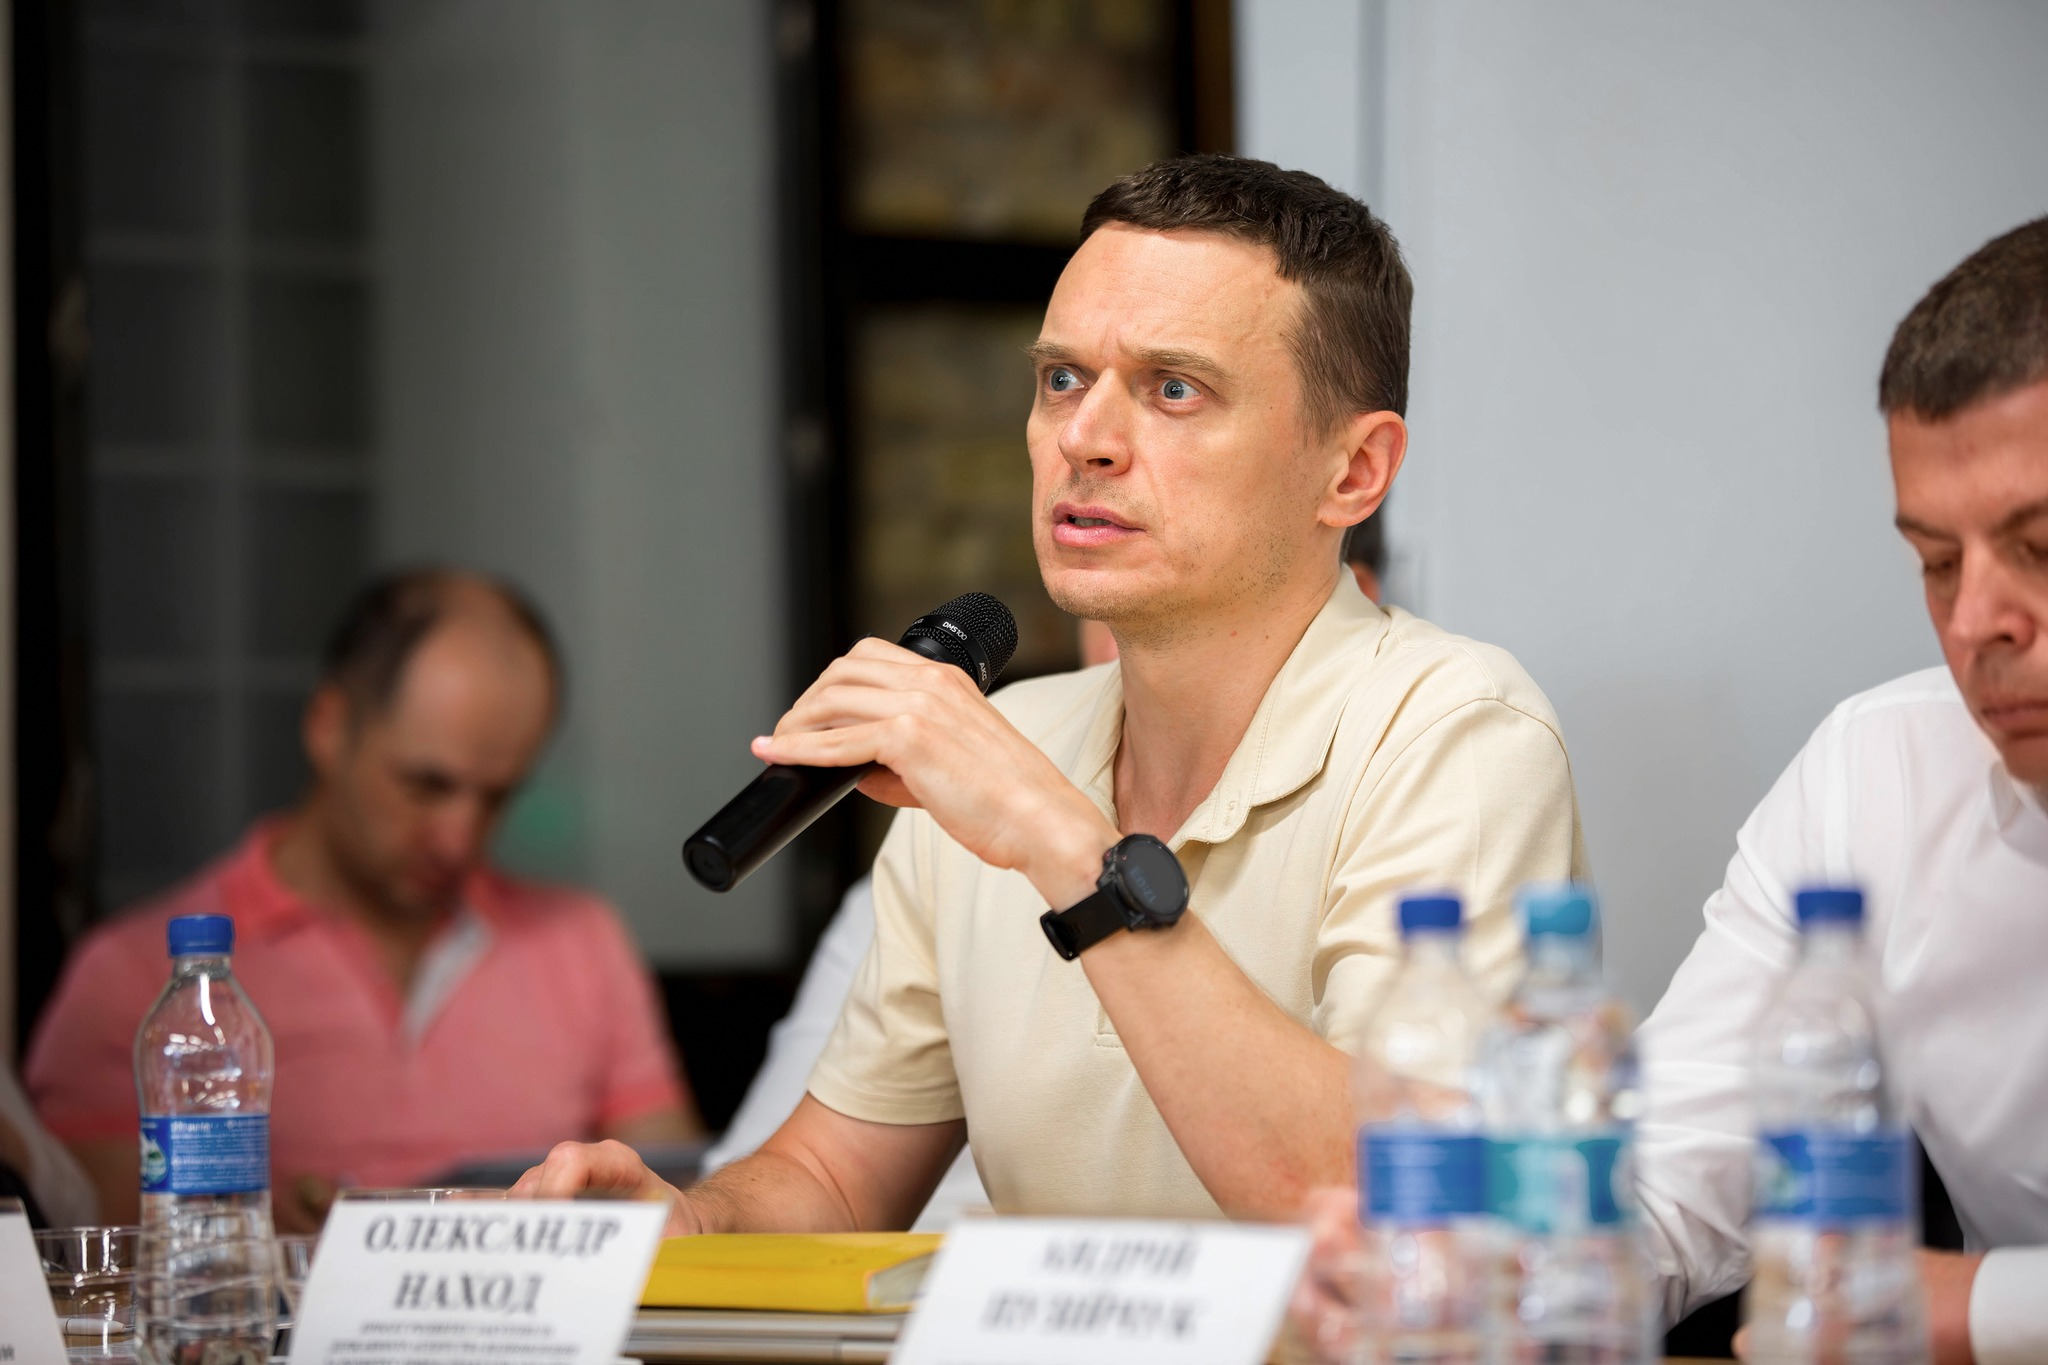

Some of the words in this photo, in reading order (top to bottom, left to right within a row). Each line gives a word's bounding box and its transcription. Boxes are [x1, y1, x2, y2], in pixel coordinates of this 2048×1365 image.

[942, 621, 968, 641] DMS100
[979, 662, 988, 681] AKG
[363, 1213, 621, 1258] ОЛЕКСАНДР
[393, 1271, 545, 1314] НАХОД
